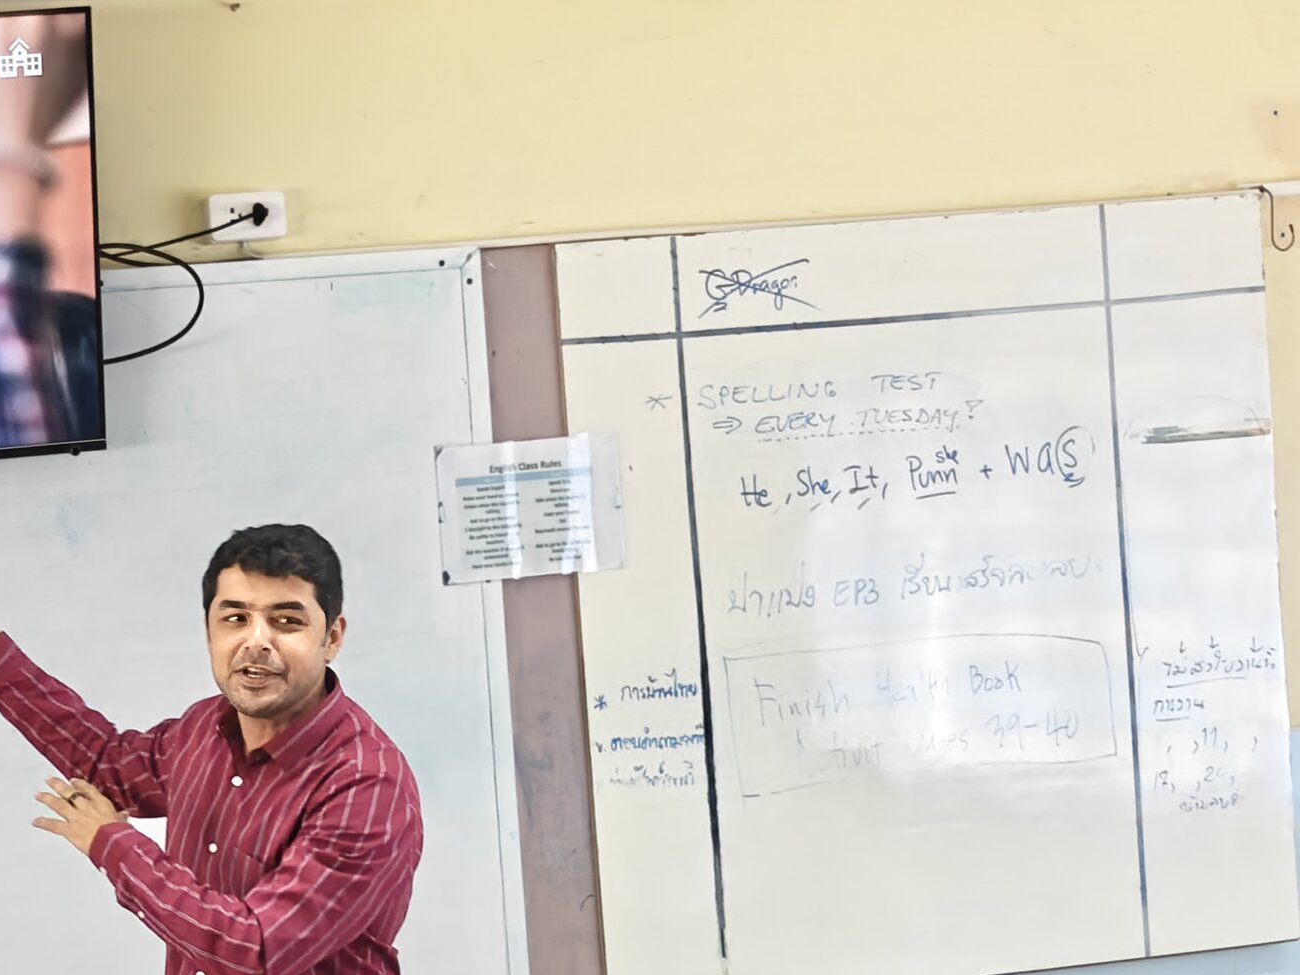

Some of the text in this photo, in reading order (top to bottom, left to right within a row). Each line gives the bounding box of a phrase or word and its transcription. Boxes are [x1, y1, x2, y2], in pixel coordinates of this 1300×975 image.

[697, 371, 943, 409] SPELLING TEST
[754, 413, 836, 434] EVERY
[833, 578, 880, 607] EP3
